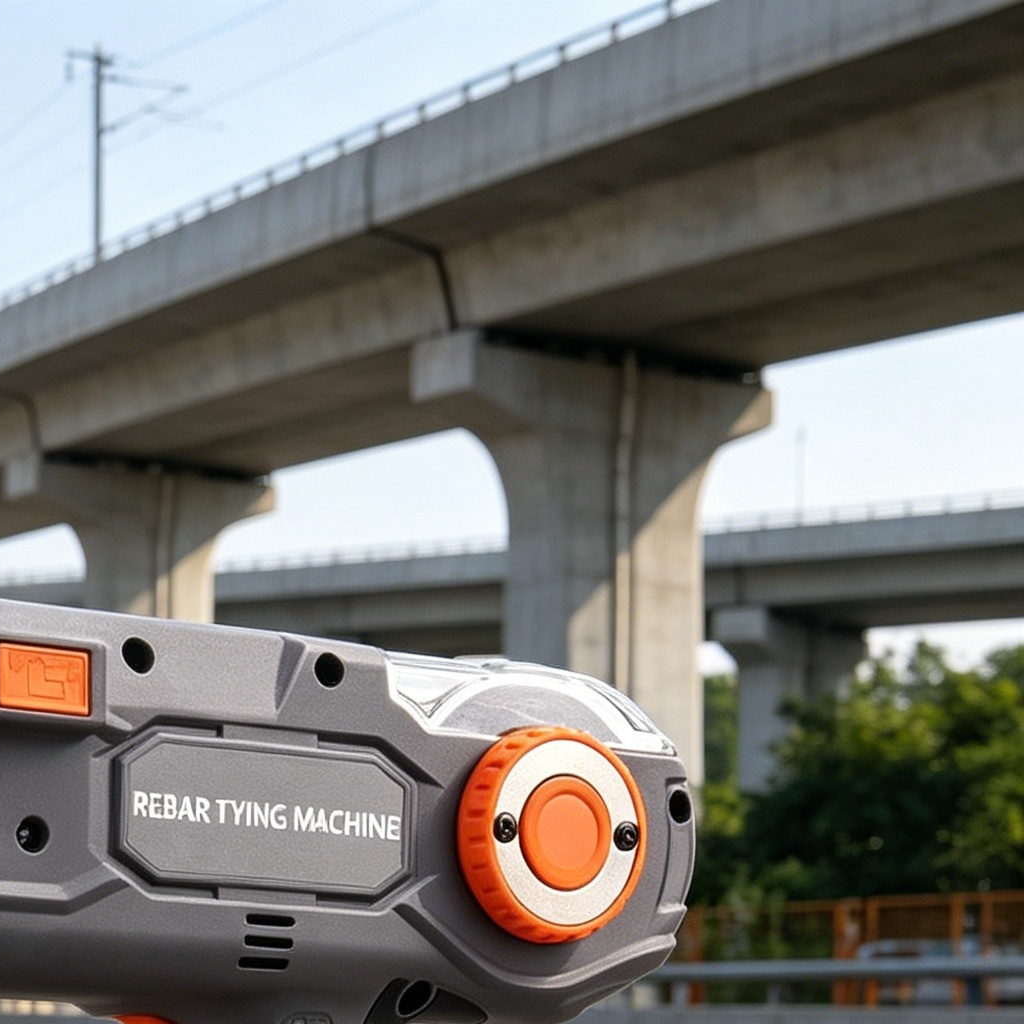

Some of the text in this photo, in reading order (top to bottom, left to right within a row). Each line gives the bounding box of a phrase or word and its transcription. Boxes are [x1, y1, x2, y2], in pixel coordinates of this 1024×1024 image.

[133, 790, 401, 841] REBAR TYING MACHINE
